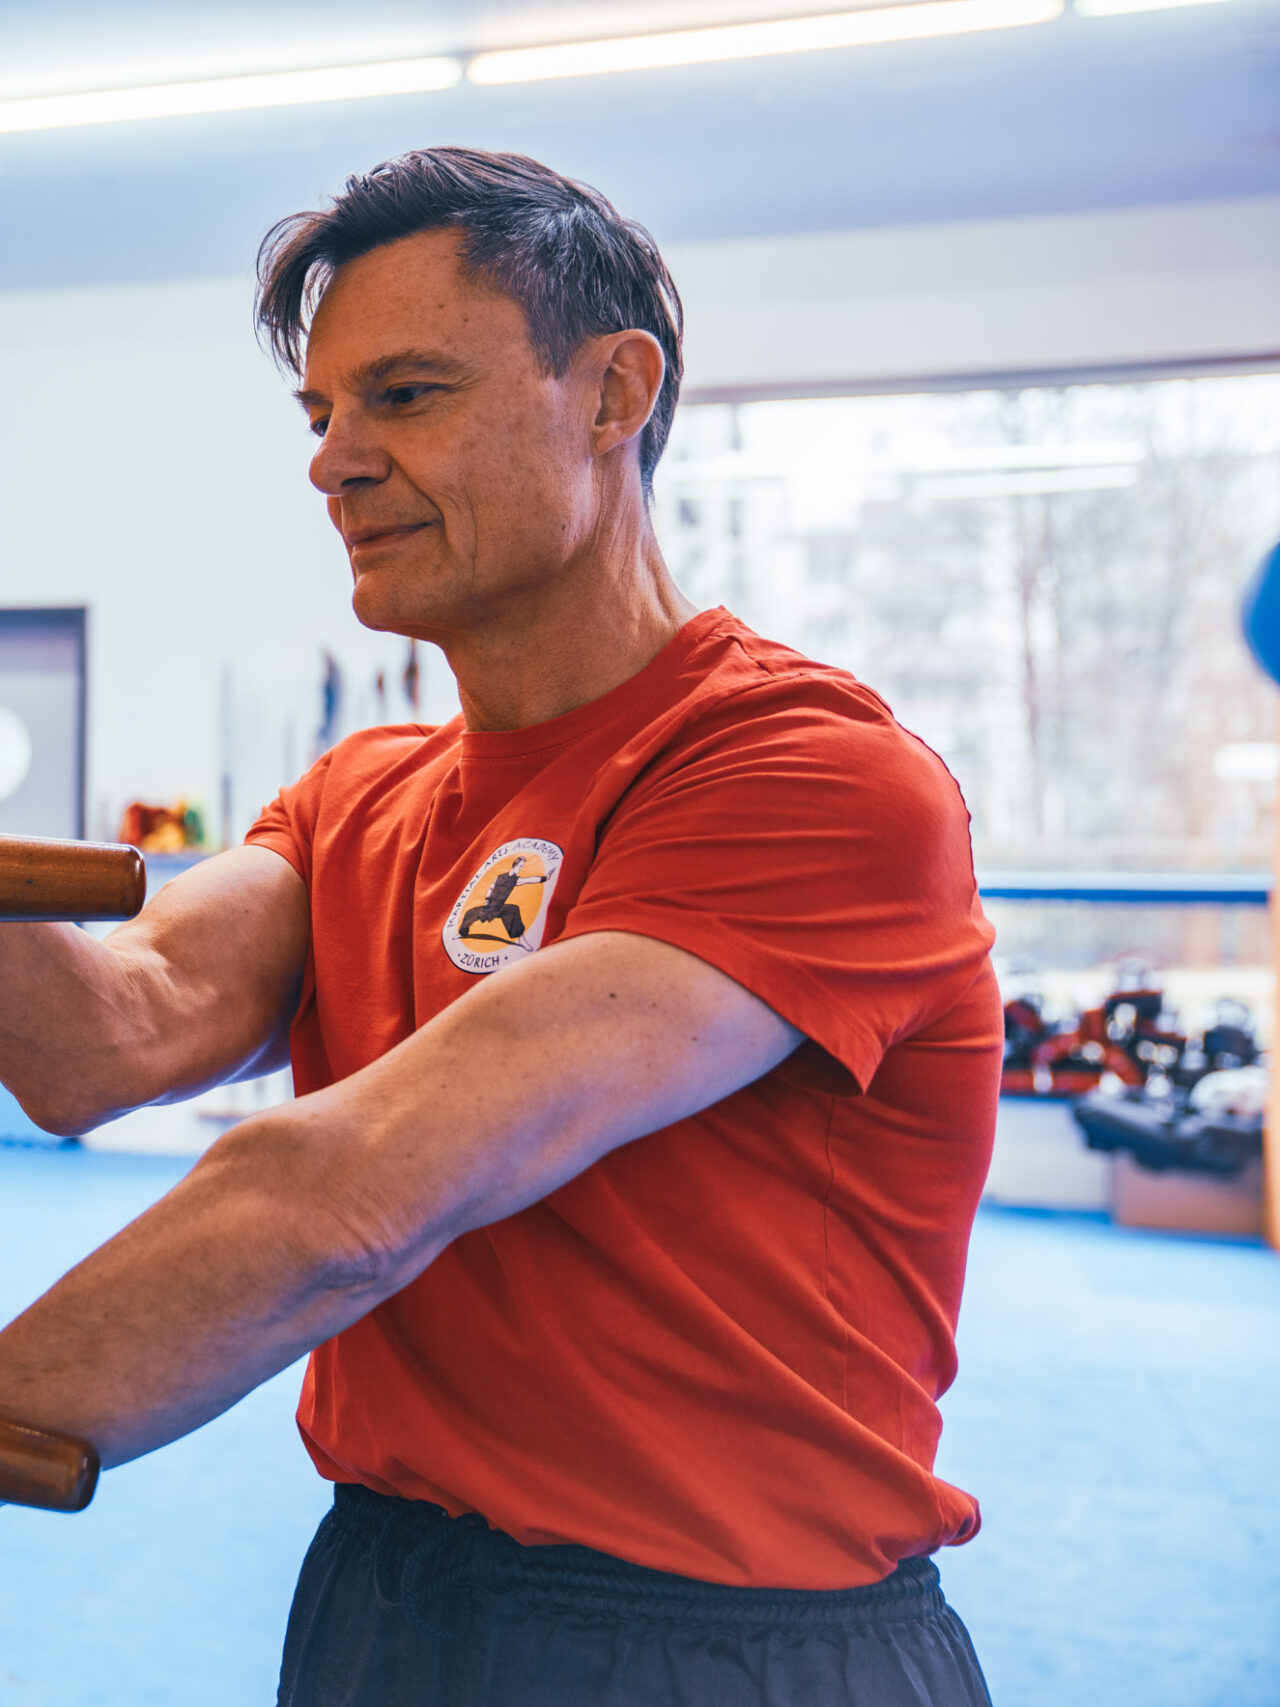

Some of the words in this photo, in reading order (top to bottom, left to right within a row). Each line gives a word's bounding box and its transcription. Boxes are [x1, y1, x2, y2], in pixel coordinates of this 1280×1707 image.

[484, 848, 508, 870] ARTS
[513, 840, 560, 861] ACADEMY
[460, 953, 500, 968] ZÜRICH
